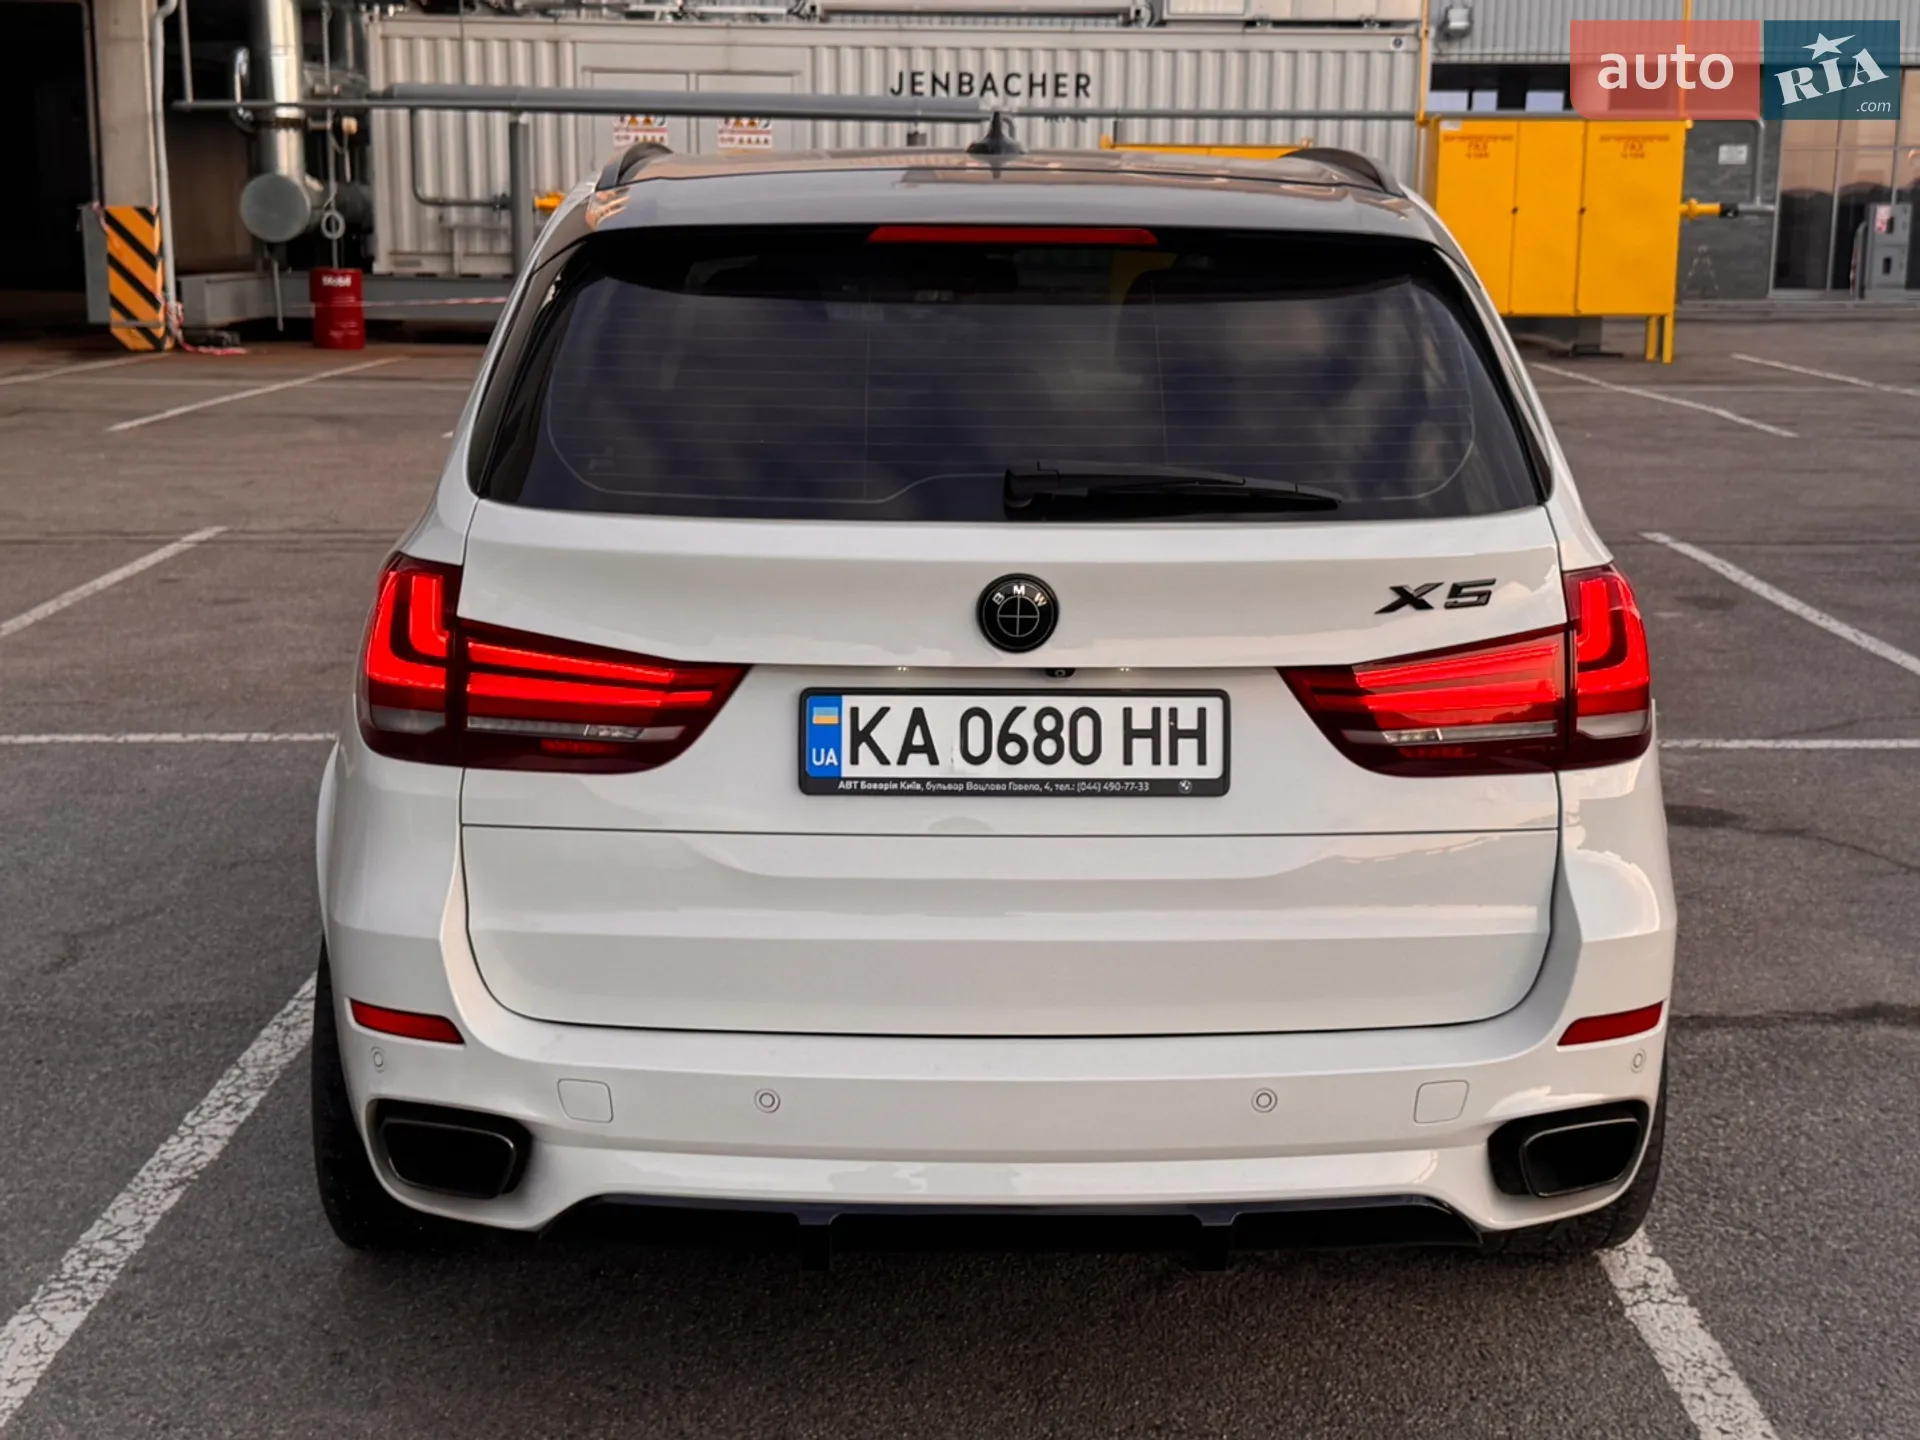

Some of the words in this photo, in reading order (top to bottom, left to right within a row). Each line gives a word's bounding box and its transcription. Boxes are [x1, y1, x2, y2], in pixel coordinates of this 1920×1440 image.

[889, 71, 1092, 98] JENBACHER
[991, 584, 1048, 607] BMW
[1374, 578, 1497, 615] X5
[848, 705, 940, 766] KA
[960, 705, 1102, 766] 0680
[1122, 705, 1208, 766] HH
[811, 747, 839, 767] UA
[1077, 782, 1101, 793] (044)
[1103, 781, 1150, 792] 490-77-33
